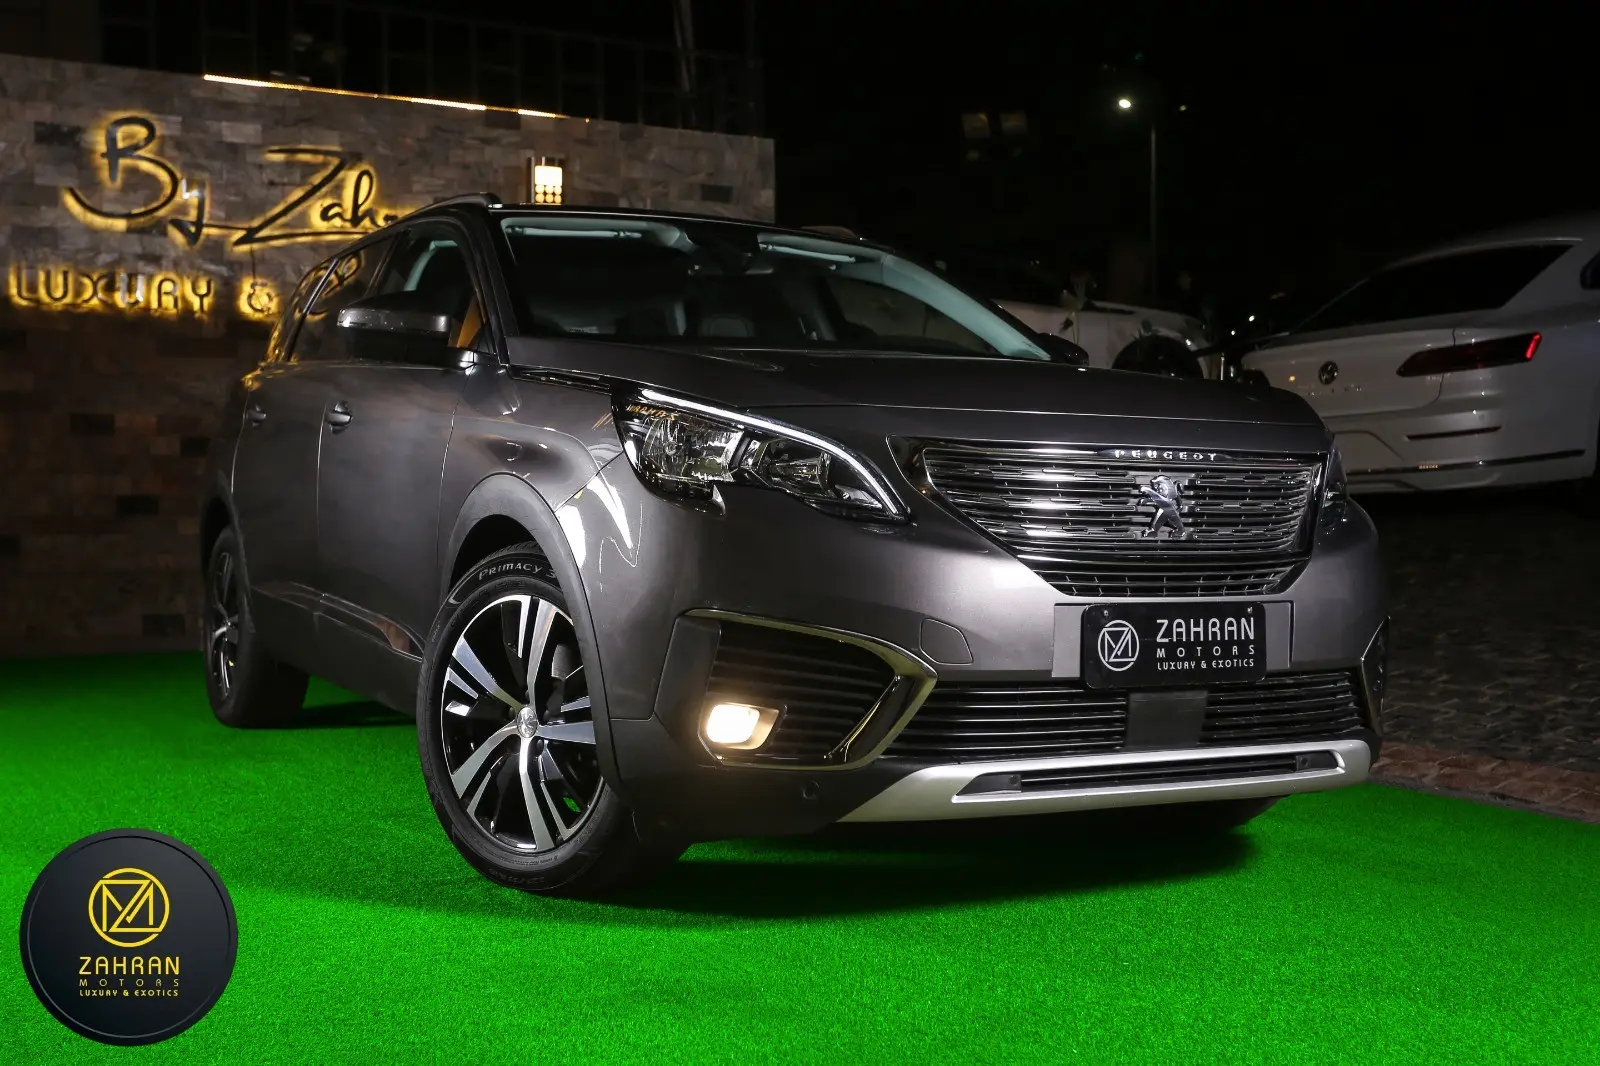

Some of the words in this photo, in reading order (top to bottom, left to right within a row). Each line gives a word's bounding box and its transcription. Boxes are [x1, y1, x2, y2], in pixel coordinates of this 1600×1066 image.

[64, 115, 205, 246] By
[232, 146, 398, 246] Zah
[14, 267, 214, 313] LUXURY
[246, 280, 277, 315] &
[1114, 449, 1218, 462] PEUGEOT
[478, 561, 544, 581] PRIMACY
[1156, 616, 1256, 643] ZAHRAN
[1156, 644, 1256, 658] MOTORS
[1156, 661, 1196, 671] LUXURY
[1200, 659, 1208, 669] &
[1211, 658, 1255, 669] EXOTICS
